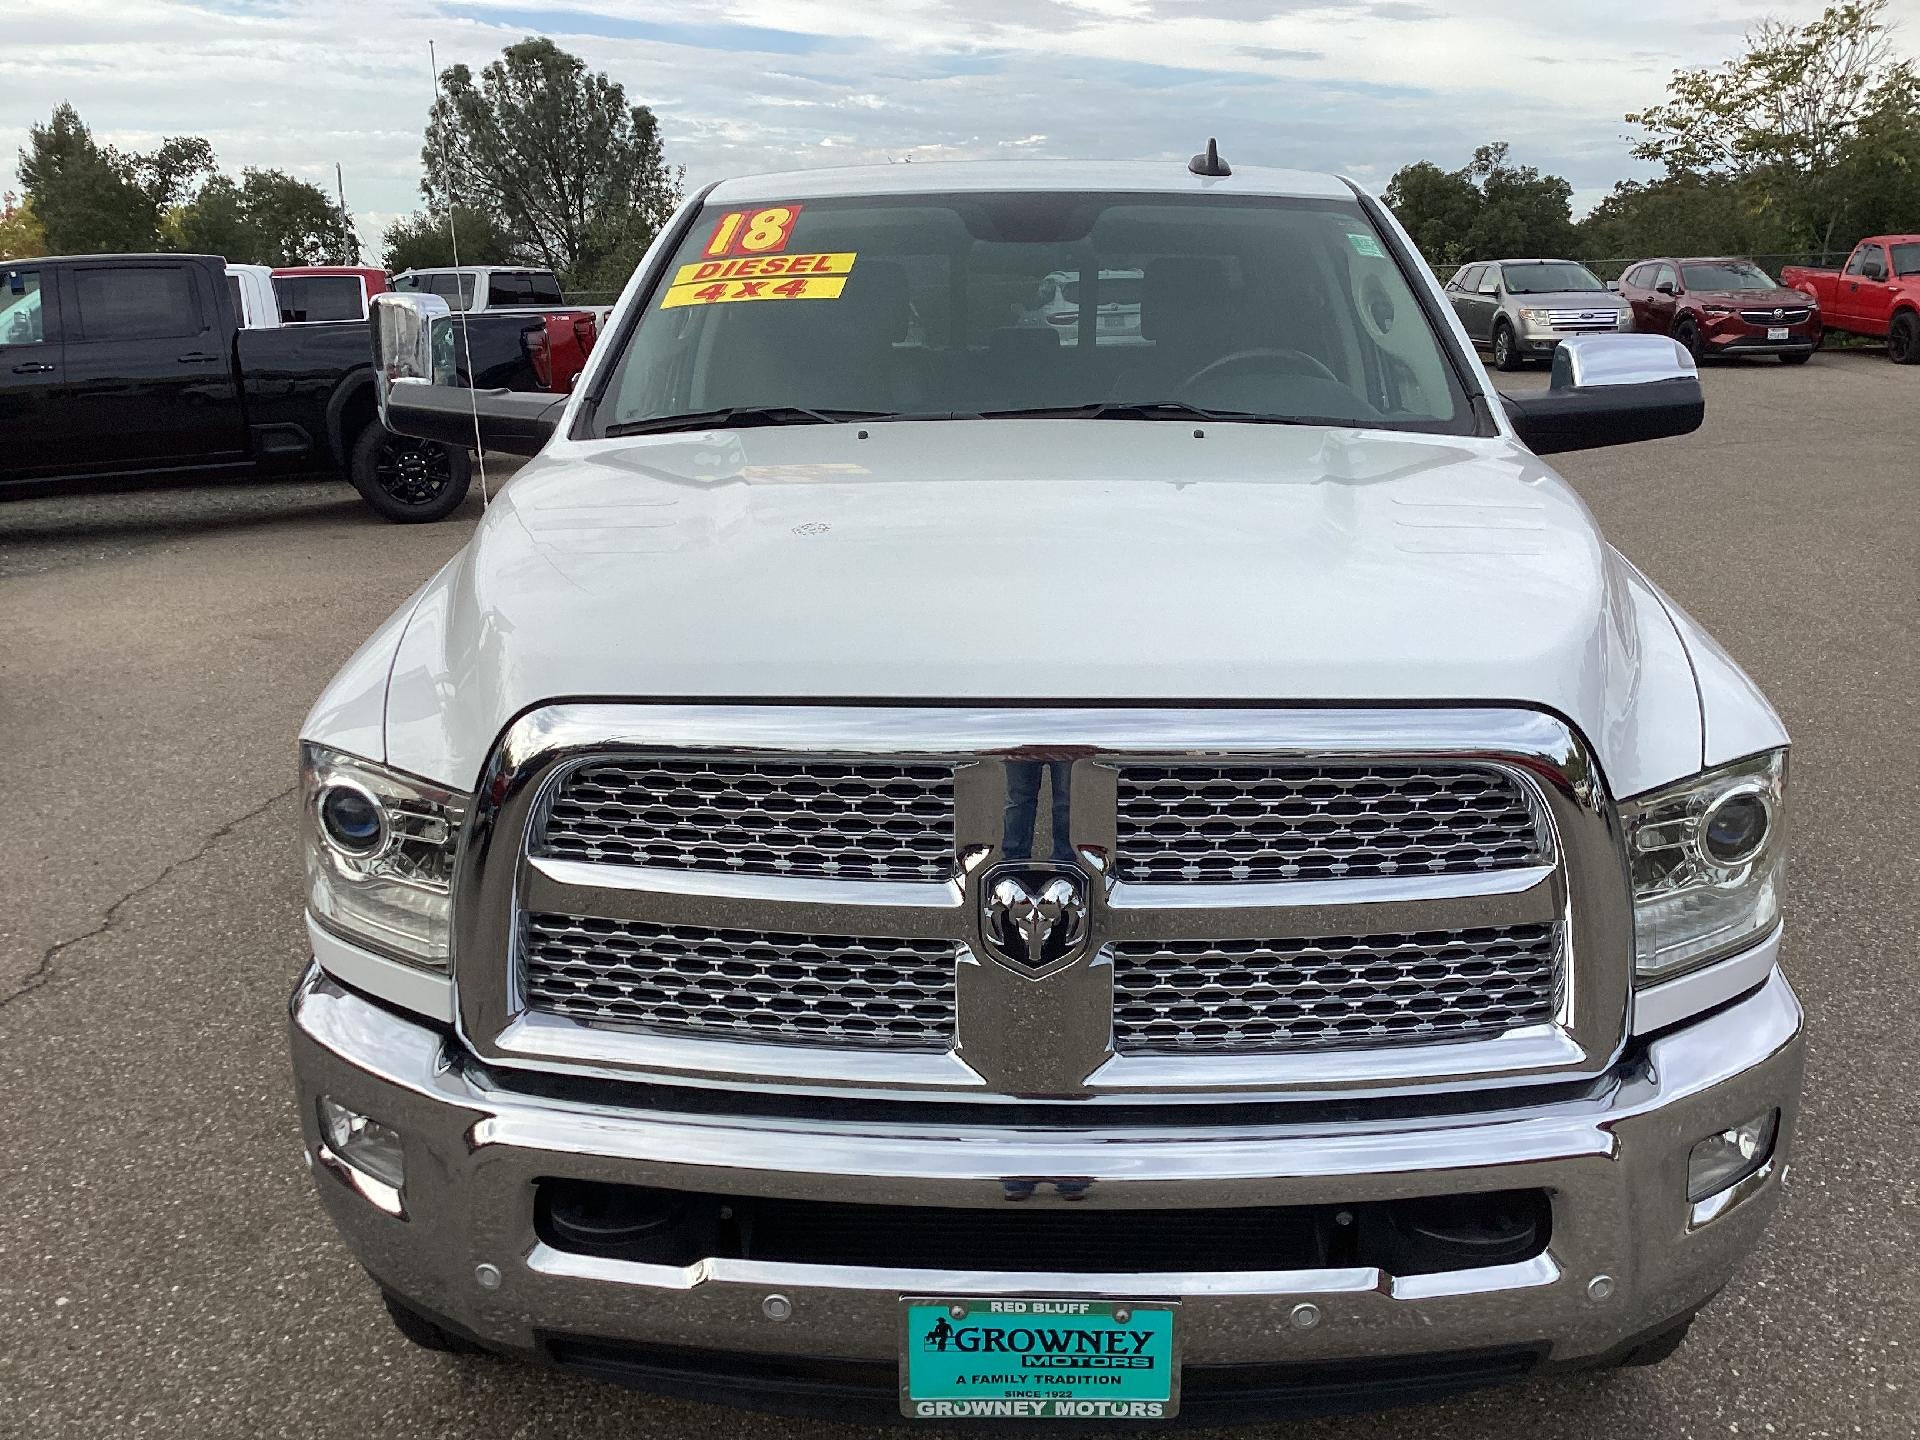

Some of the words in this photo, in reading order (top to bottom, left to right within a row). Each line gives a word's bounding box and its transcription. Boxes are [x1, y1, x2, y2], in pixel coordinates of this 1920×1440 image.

[708, 208, 793, 256] 18
[693, 255, 833, 281] DIESEL
[990, 1301, 1027, 1313] RED
[1032, 1302, 1090, 1315] BLUFF
[954, 1327, 1155, 1355] GROWNEY
[1025, 1355, 1151, 1368] MOTORS
[955, 1375, 967, 1385] A
[971, 1374, 1029, 1385] FAMILY
[1034, 1374, 1122, 1385] TRADITION
[1004, 1390, 1041, 1399] SINCE
[1045, 1390, 1073, 1399] 1922
[916, 1400, 1048, 1417] GROWNEY
[1054, 1401, 1163, 1417] MOTORS
